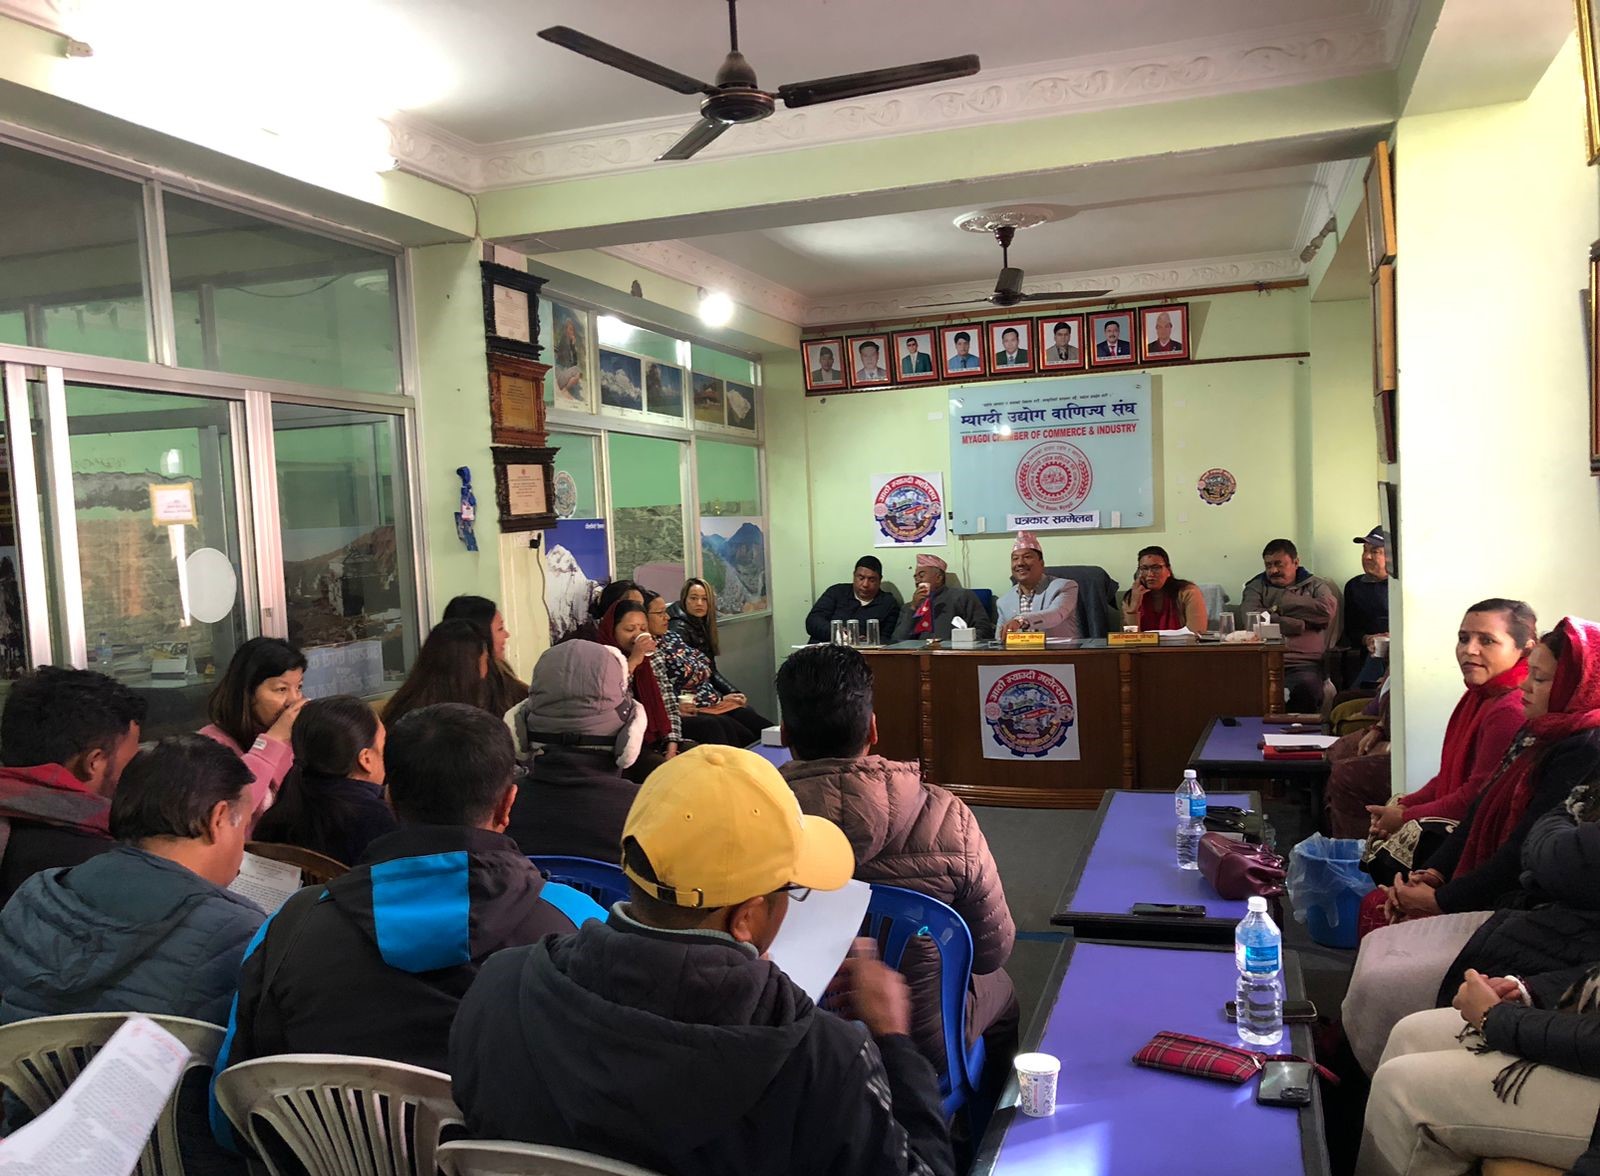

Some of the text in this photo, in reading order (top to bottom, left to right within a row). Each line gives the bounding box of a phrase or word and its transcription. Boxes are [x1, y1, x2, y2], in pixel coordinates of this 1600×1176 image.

[1008, 406, 1046, 423] उद्योग
[1052, 402, 1106, 420] वाणिज्य
[1112, 399, 1137, 416] संघ
[962, 434, 990, 445] MYAGDI
[1031, 430, 1041, 440] OF
[1043, 426, 1087, 439] COMMERCE
[1089, 426, 1094, 435] &
[1096, 423, 1137, 435] INDUSTRY
[1014, 513, 1093, 526] पत्रकार सम्मेलन
